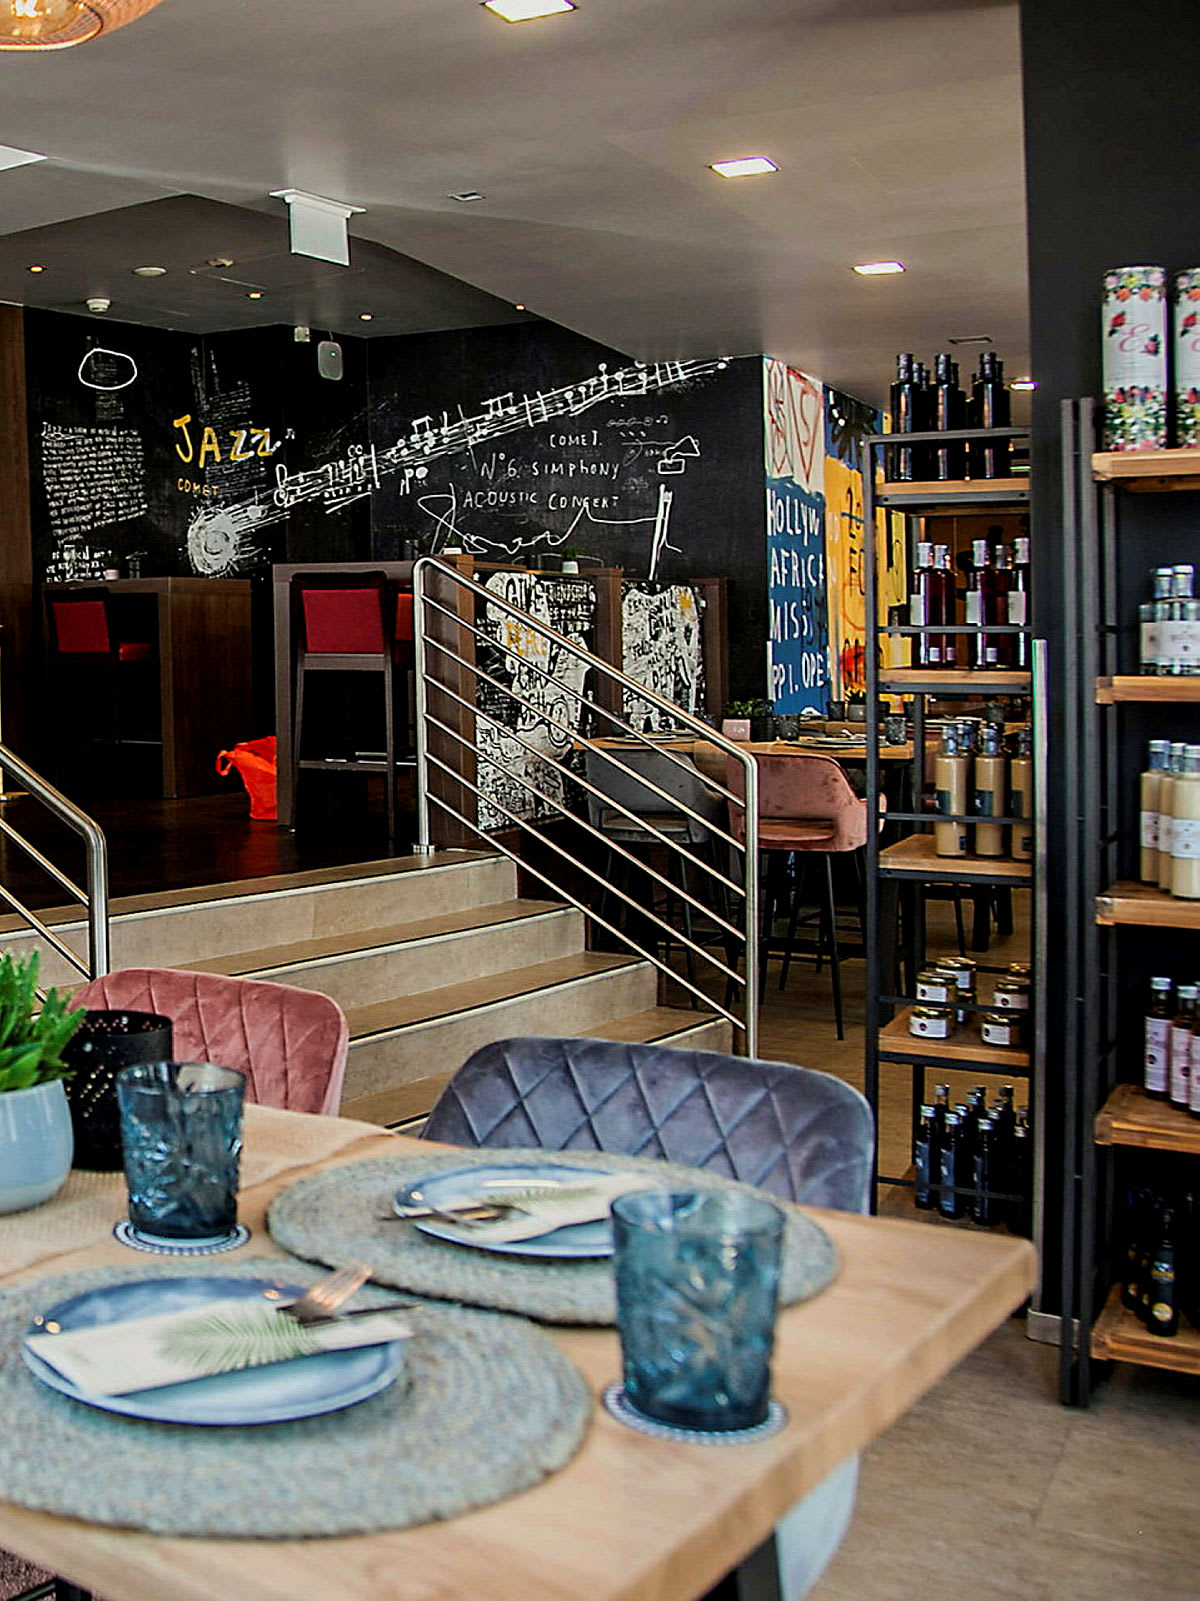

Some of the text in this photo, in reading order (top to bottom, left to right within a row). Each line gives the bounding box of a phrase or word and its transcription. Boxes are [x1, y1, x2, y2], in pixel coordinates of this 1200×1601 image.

[173, 414, 279, 468] JAZZ
[177, 478, 220, 497] COMET
[462, 491, 538, 509] ACOUSTIC
[766, 488, 821, 547] HOLLYW
